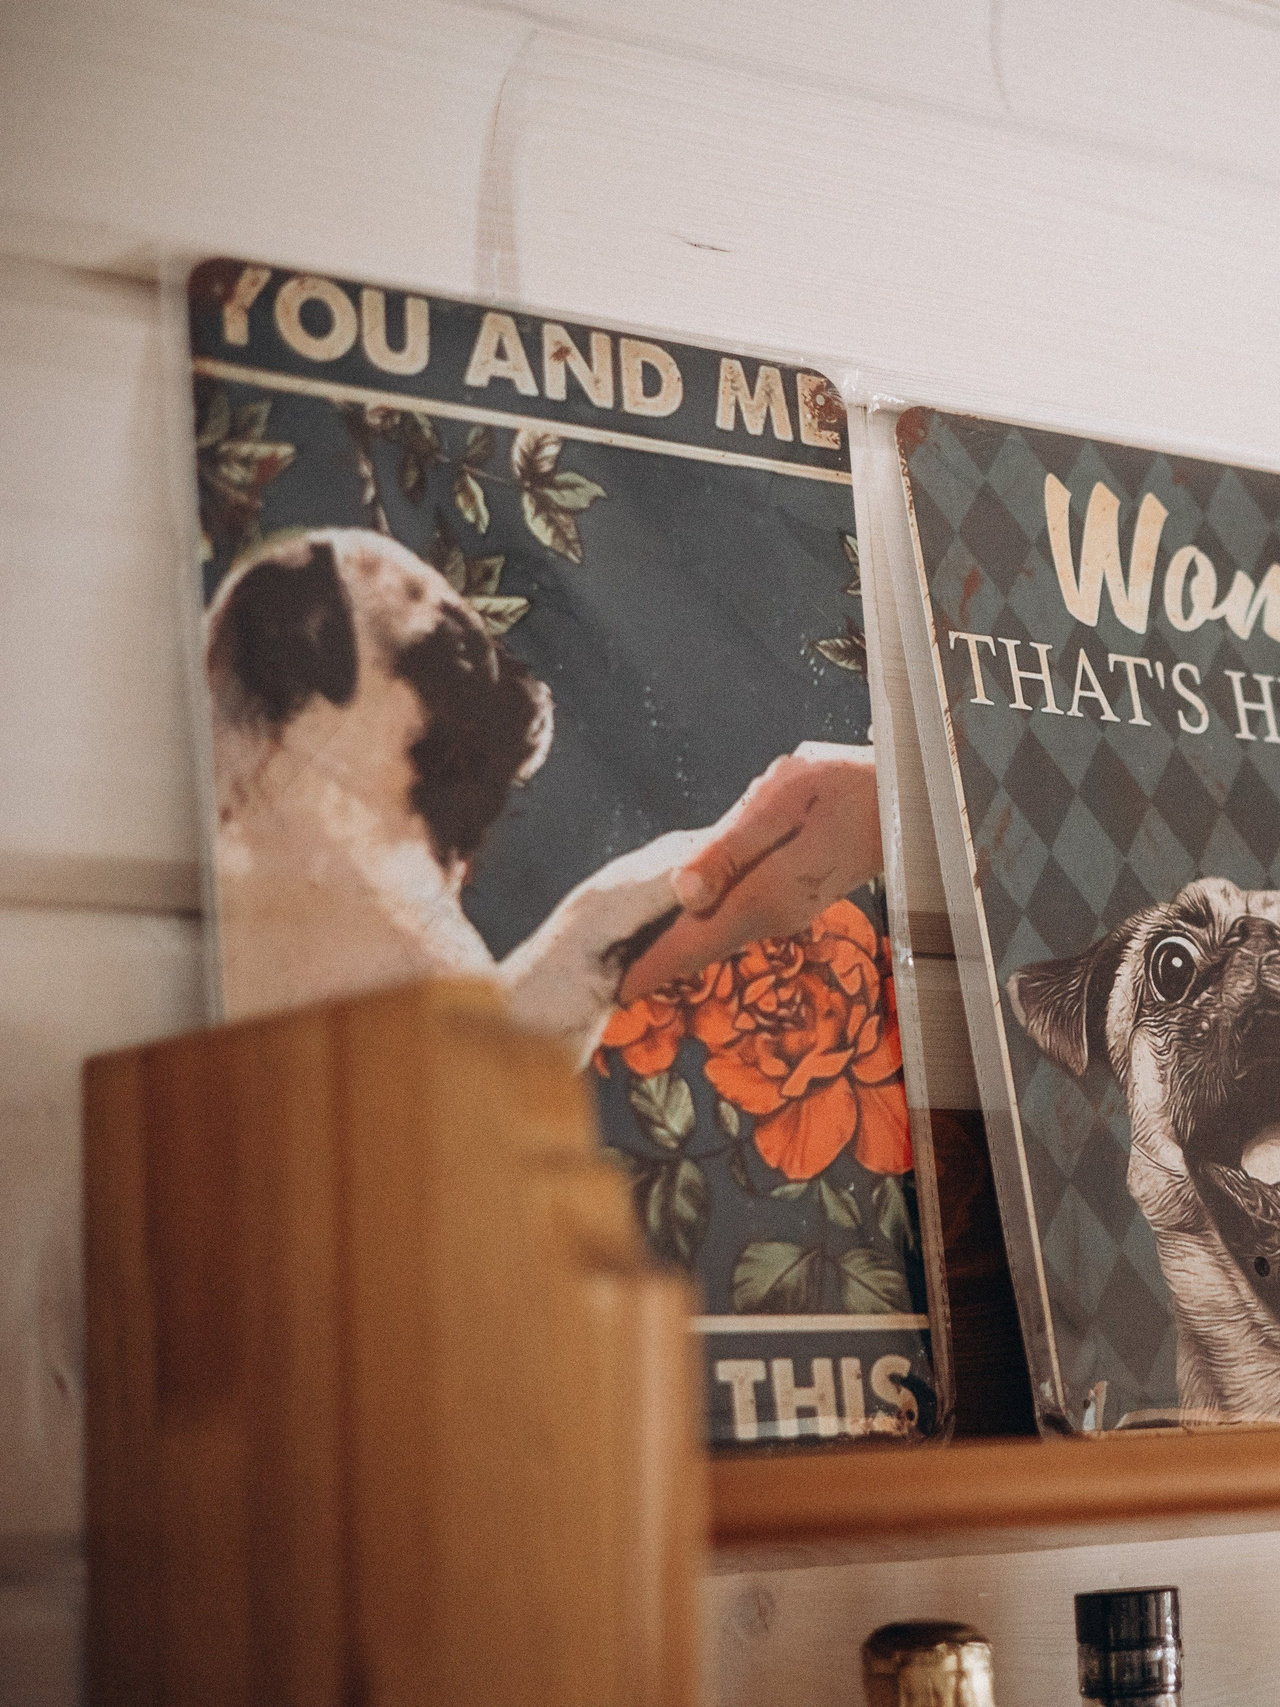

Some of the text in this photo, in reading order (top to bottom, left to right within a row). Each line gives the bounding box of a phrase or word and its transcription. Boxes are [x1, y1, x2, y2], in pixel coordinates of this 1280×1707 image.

[216, 268, 842, 450] YOU AND ME
[948, 630, 1211, 736] THAT'S
[715, 1354, 918, 1442] THIS
